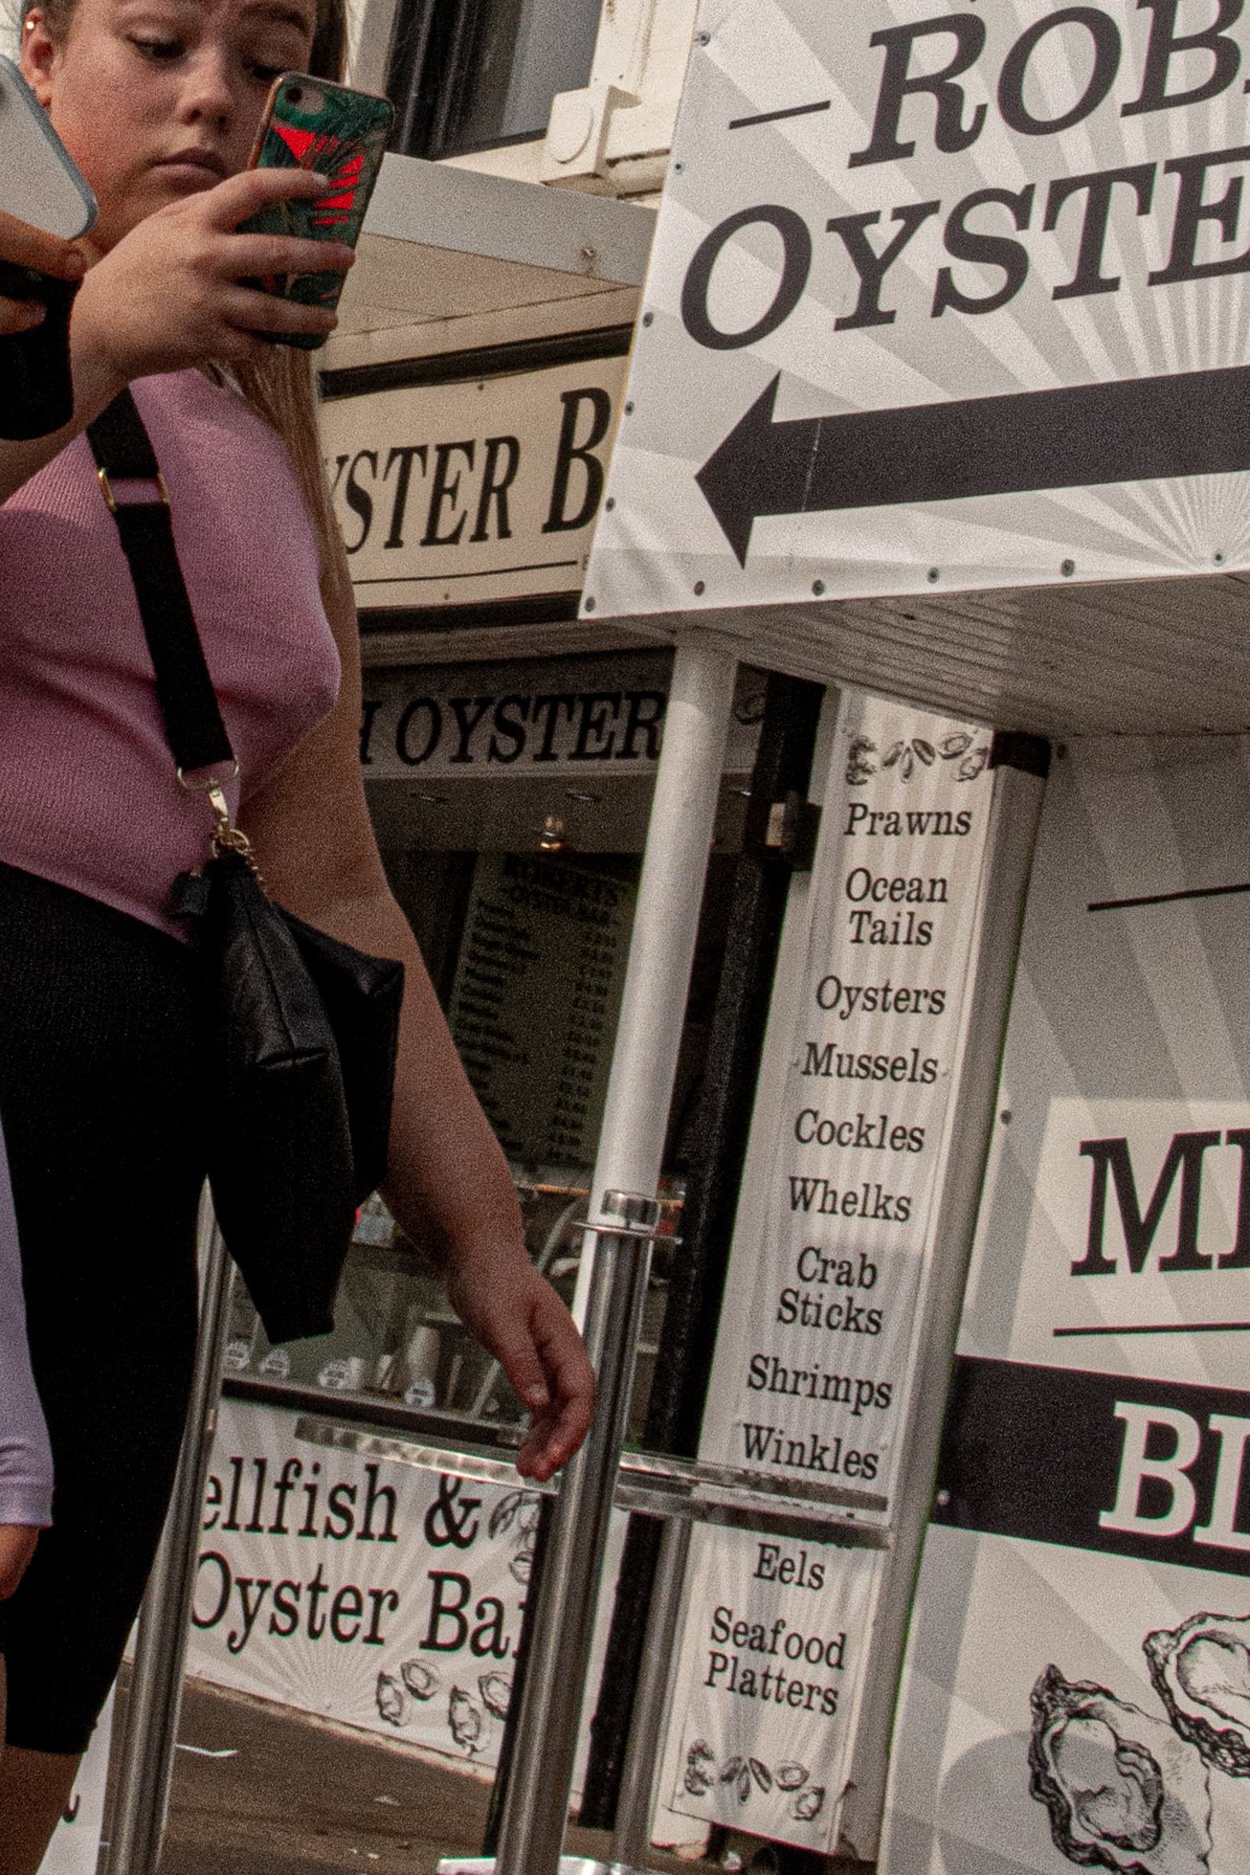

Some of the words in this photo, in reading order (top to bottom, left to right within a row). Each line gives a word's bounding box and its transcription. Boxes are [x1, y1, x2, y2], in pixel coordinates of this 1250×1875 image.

[679, 145, 1250, 351] OYSTE
[396, 691, 667, 766] OYSTER
[843, 802, 972, 836] Prawns
[845, 867, 948, 903] Ocean
[850, 910, 934, 946] Tails
[816, 975, 946, 1019] Oysters
[802, 1042, 938, 1084] Mussels
[794, 1109, 925, 1152] Cockles
[789, 1176, 912, 1222] Whelks
[796, 1246, 878, 1290] Crab
[776, 1288, 883, 1335] Sticks
[748, 1354, 892, 1416] Shrimps
[743, 1422, 880, 1480] Winkles
[424, 1472, 481, 1549] &
[753, 1543, 826, 1590] Eels
[191, 1549, 398, 1654] Oyster
[419, 1570, 525, 1660] Ba
[711, 1606, 847, 1670] Seafood
[704, 1652, 840, 1716] Platters
